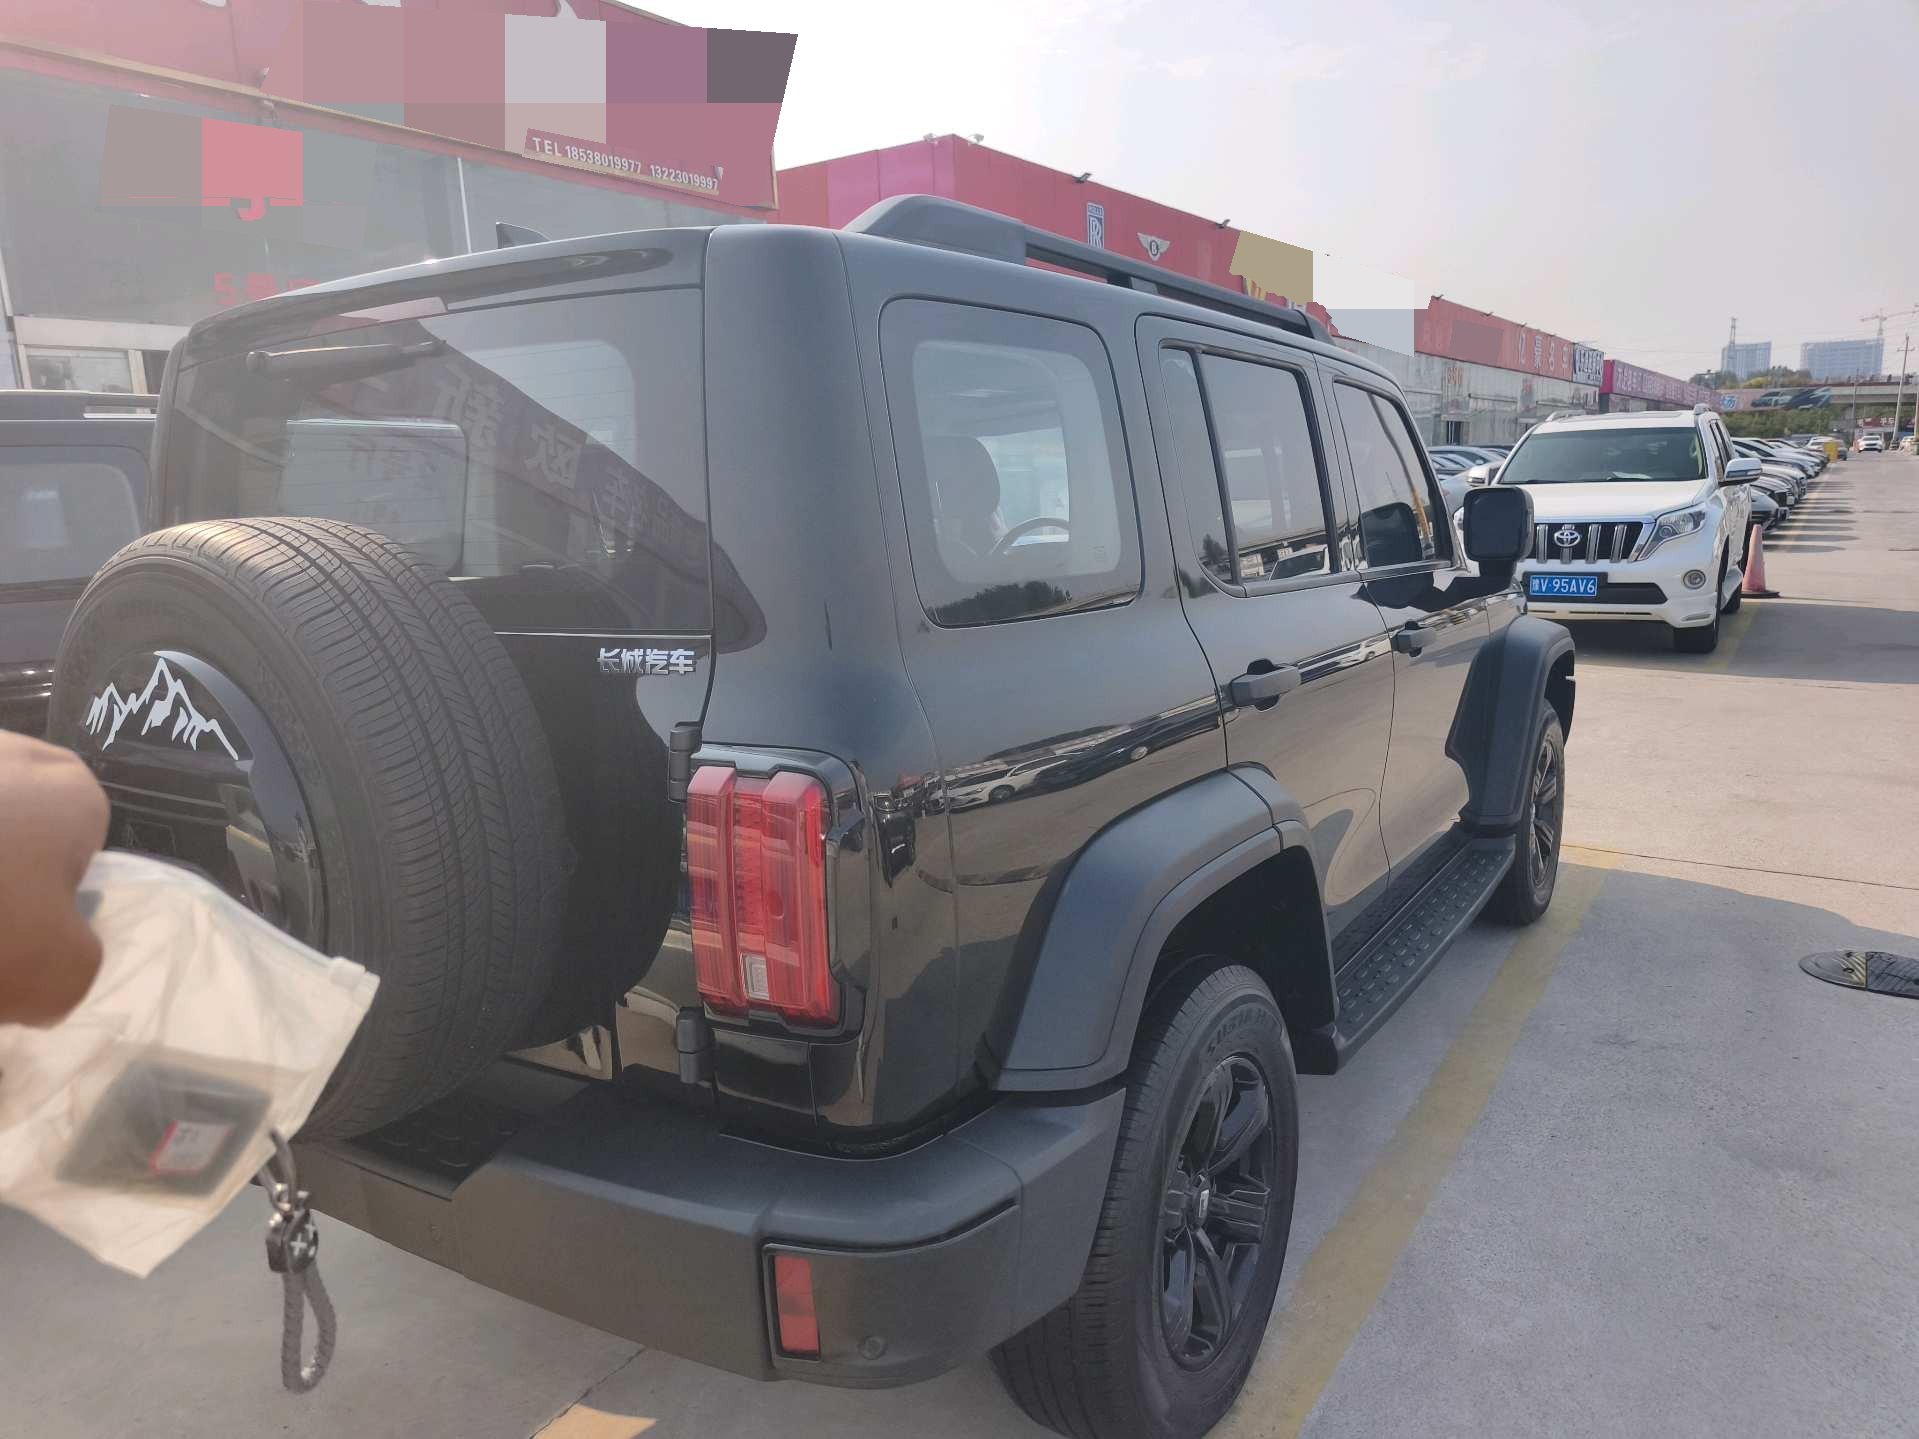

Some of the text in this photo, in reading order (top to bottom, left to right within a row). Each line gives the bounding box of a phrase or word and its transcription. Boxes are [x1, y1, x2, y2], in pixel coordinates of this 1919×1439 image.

[532, 137, 719, 190] TEL 18538019977 13223019997
[597, 647, 695, 675] 长城汽车
